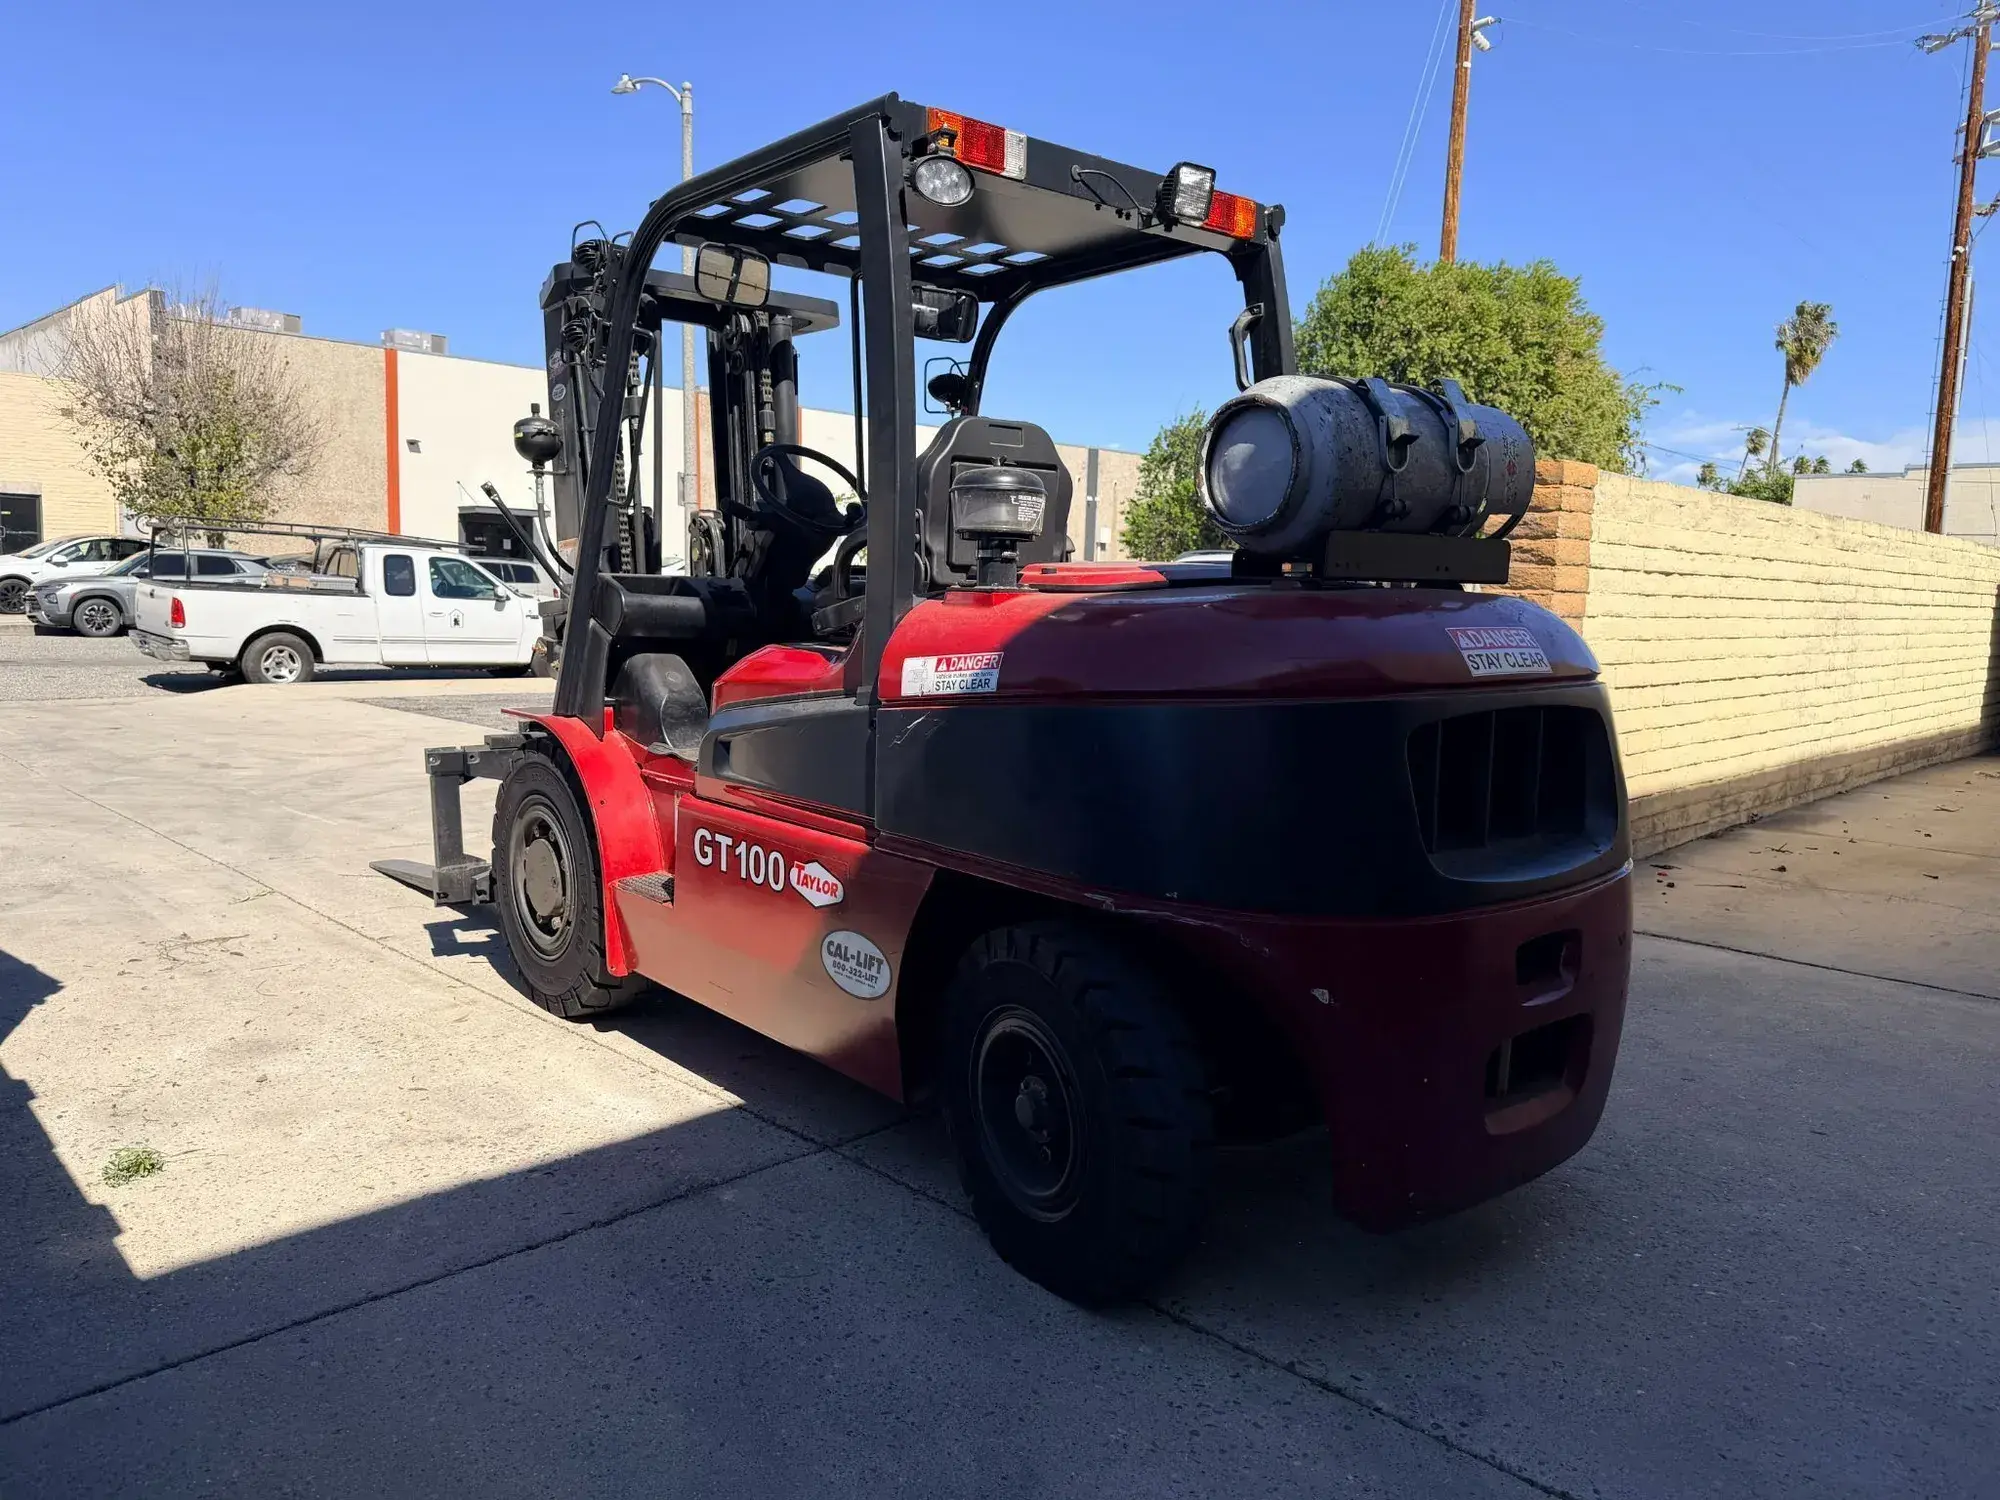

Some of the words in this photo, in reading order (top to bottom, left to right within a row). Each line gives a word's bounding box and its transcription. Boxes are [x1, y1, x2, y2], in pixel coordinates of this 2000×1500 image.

[1467, 629, 1538, 648] DANGER
[949, 654, 999, 671] DANGER
[1467, 653, 1504, 671] STAY
[1504, 652, 1548, 668] CLEAR
[935, 680, 957, 691] STAY
[959, 678, 991, 690] CLEAR
[693, 827, 786, 892] GT100
[794, 861, 839, 898] TAYLOR
[826, 940, 884, 975] CAL-LIFT
